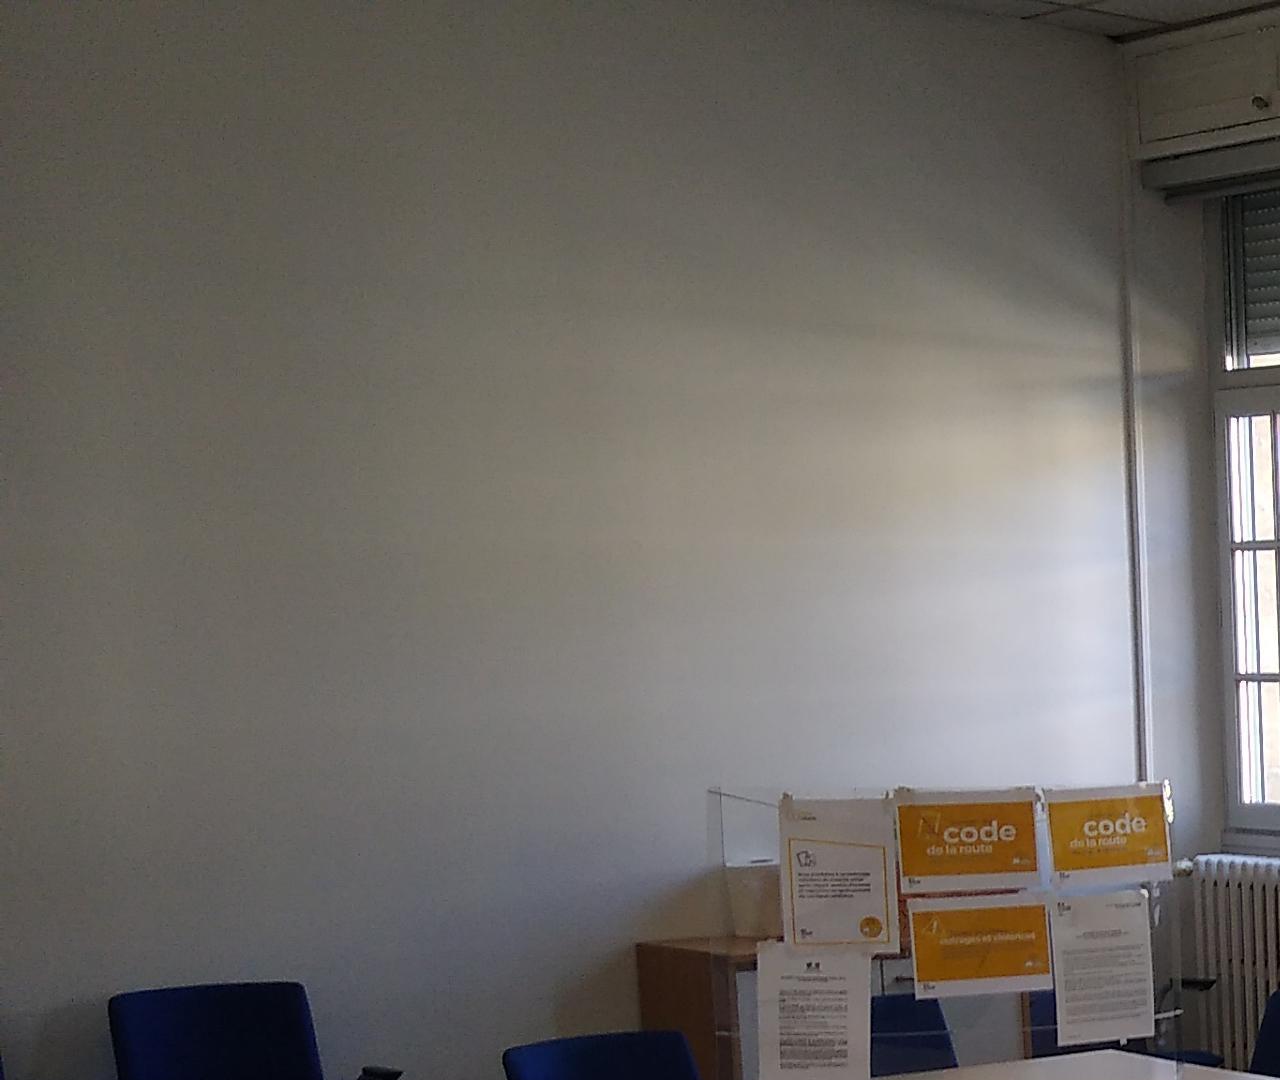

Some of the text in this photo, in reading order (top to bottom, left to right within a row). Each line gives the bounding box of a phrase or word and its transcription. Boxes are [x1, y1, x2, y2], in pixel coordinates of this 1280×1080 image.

[943, 819, 1017, 843] code
[1083, 811, 1149, 836] code
[926, 842, 993, 857] de la route
[1070, 835, 1128, 848] de la route
